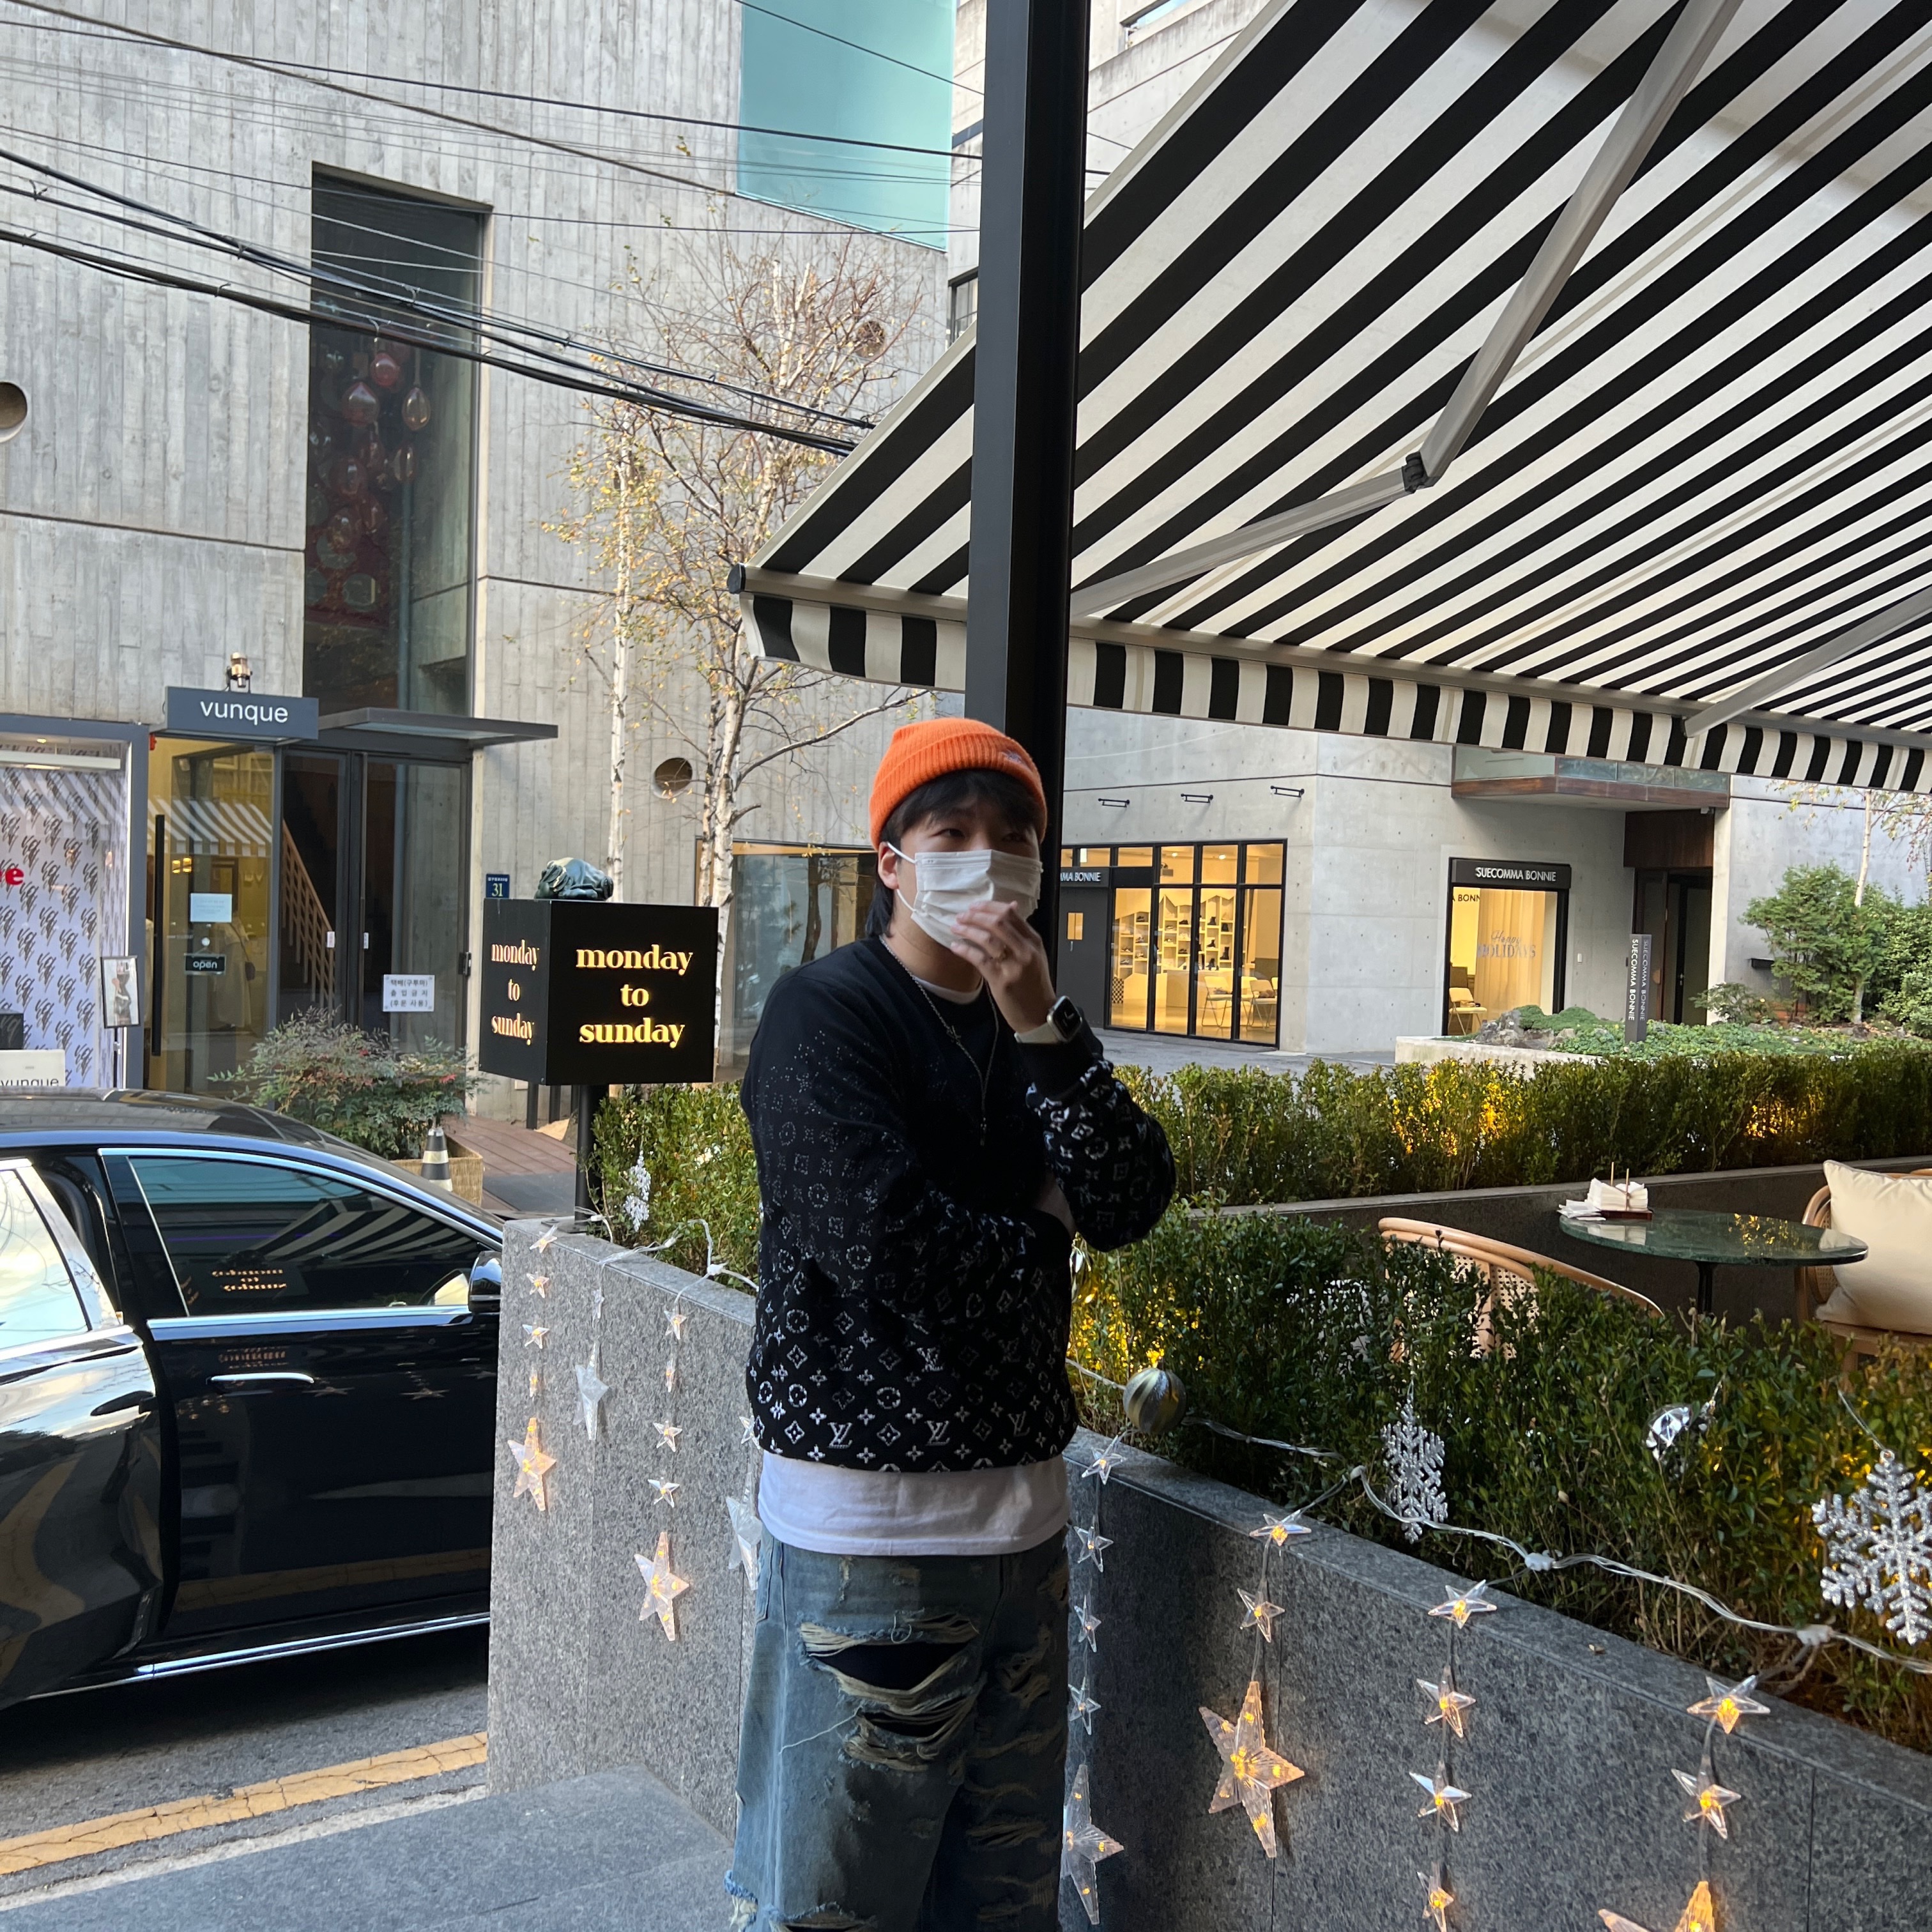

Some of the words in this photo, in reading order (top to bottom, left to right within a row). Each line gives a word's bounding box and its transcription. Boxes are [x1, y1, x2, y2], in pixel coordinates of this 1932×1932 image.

[200, 701, 288, 725] vunque
[1075, 872, 1101, 882] BONNIE
[1475, 867, 1523, 880] SUECOMMA
[1526, 870, 1556, 881] BONNIE
[491, 883, 503, 897] 31
[193, 960, 217, 970] open
[491, 939, 539, 971] monday
[576, 944, 693, 976] monday
[1630, 939, 1639, 986] SUECOMMA
[507, 978, 520, 1000] to
[620, 984, 649, 1006] to
[491, 1012, 535, 1045] sunday
[579, 1017, 685, 1048] sunday
